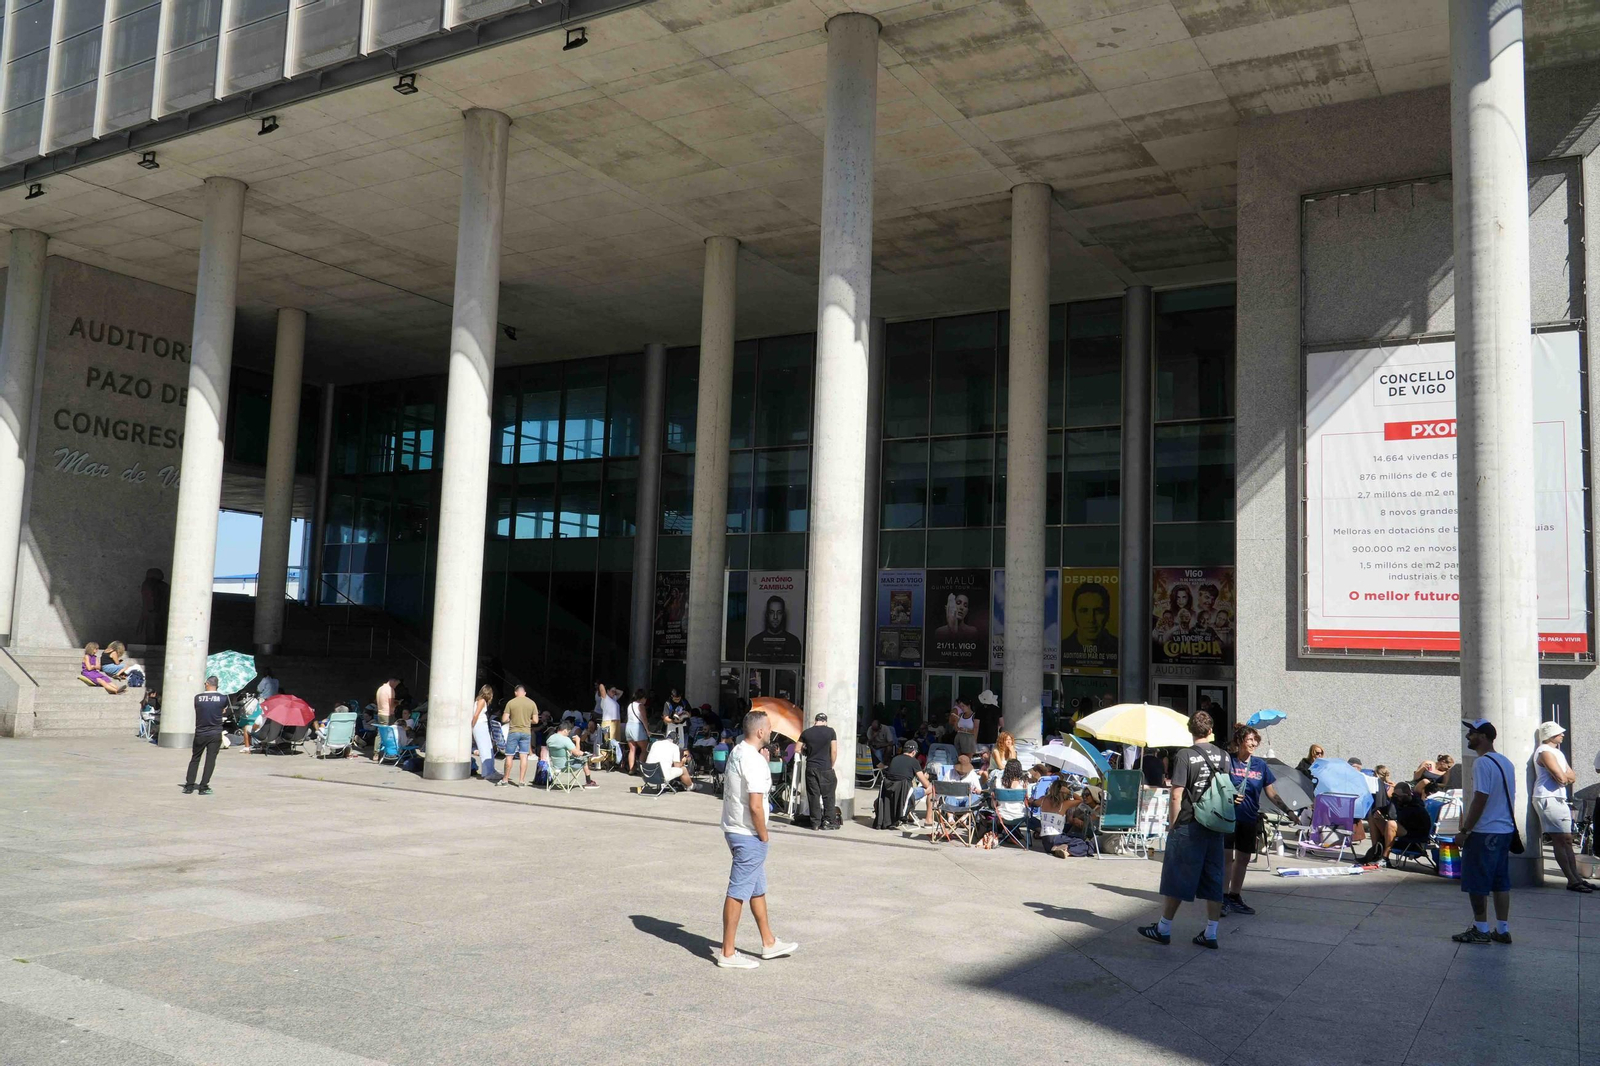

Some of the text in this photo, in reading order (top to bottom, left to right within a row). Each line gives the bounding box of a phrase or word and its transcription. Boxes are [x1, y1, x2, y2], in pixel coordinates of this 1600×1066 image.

[86, 366, 152, 398] PAZO
[1380, 370, 1454, 384] CONCELLO
[1389, 384, 1446, 396] DE VIGO
[54, 408, 184, 449] CONGRES
[53, 446, 110, 478] Mar
[121, 461, 147, 484] de
[1420, 508, 1458, 516] grandes
[944, 574, 974, 585] MALÚ
[1064, 576, 1118, 584] DEPEDRO
[1349, 591, 1460, 600] O mellor futuro
[1083, 645, 1098, 653] VIGO
[1163, 640, 1222, 657] COMEDIA
